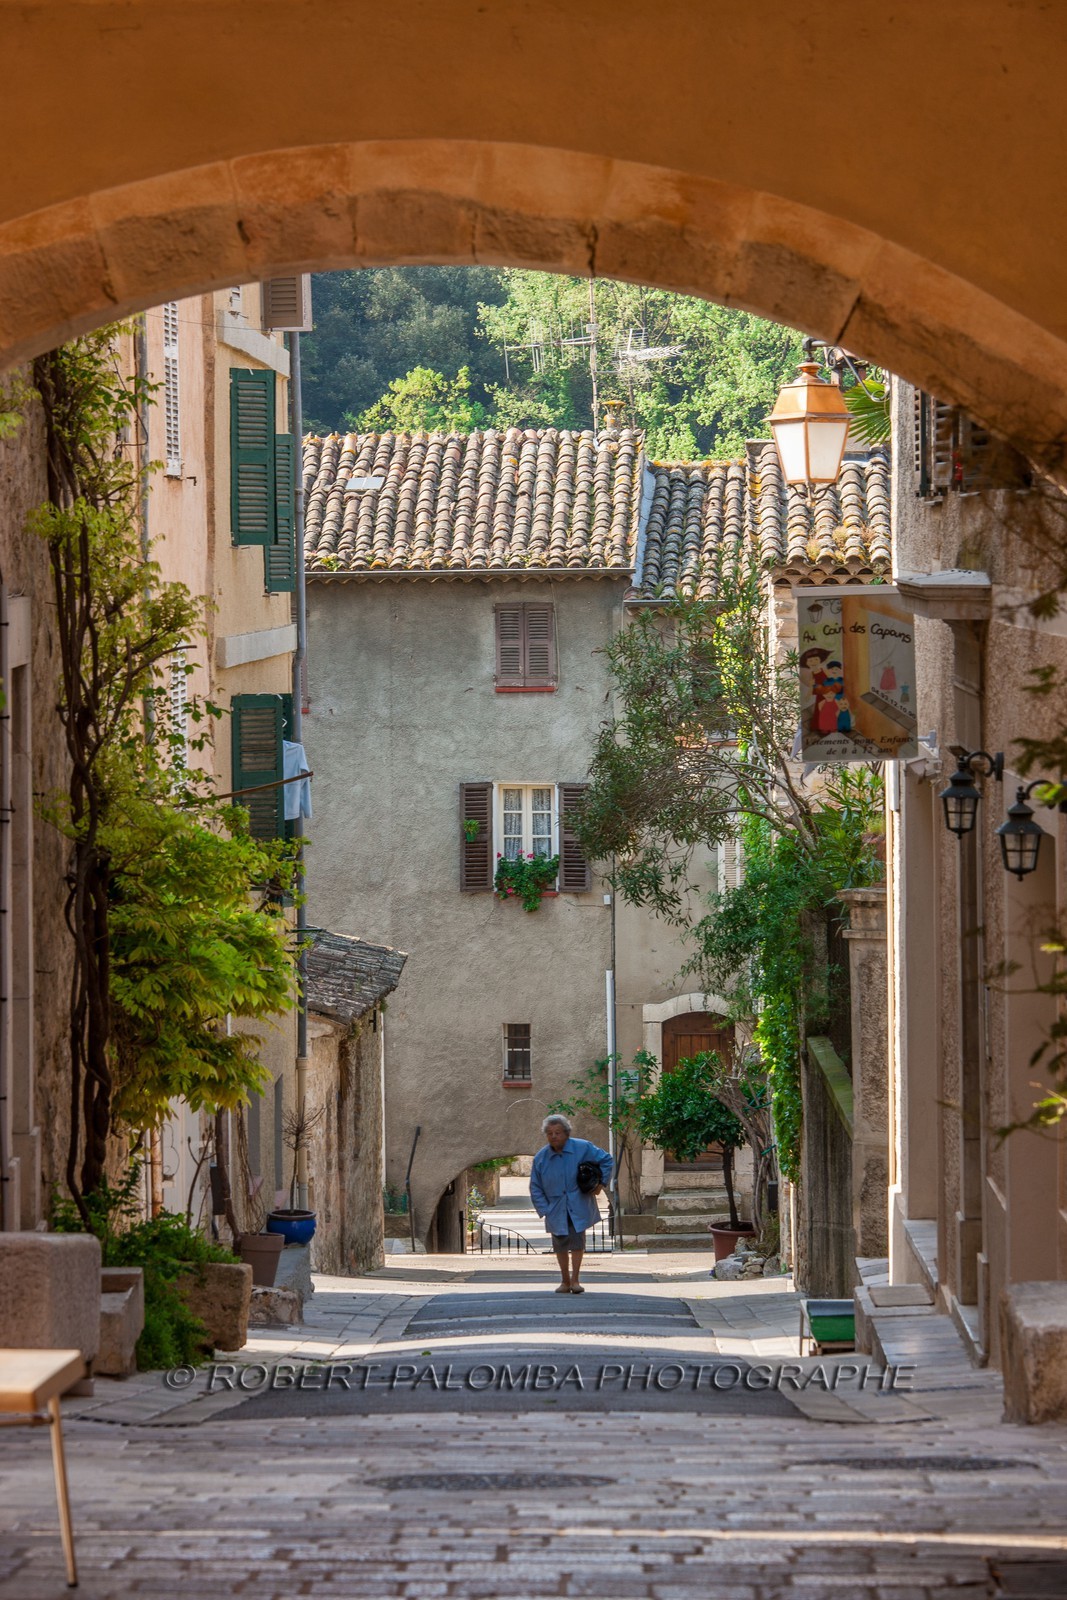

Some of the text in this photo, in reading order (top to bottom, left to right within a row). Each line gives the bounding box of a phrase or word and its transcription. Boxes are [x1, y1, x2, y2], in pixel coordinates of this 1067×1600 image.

[803, 630, 816, 643] Au
[823, 622, 846, 636] Coin
[849, 622, 866, 634] des
[805, 736, 915, 746] Vêtements pour Enfants
[863, 746, 873, 754] 12
